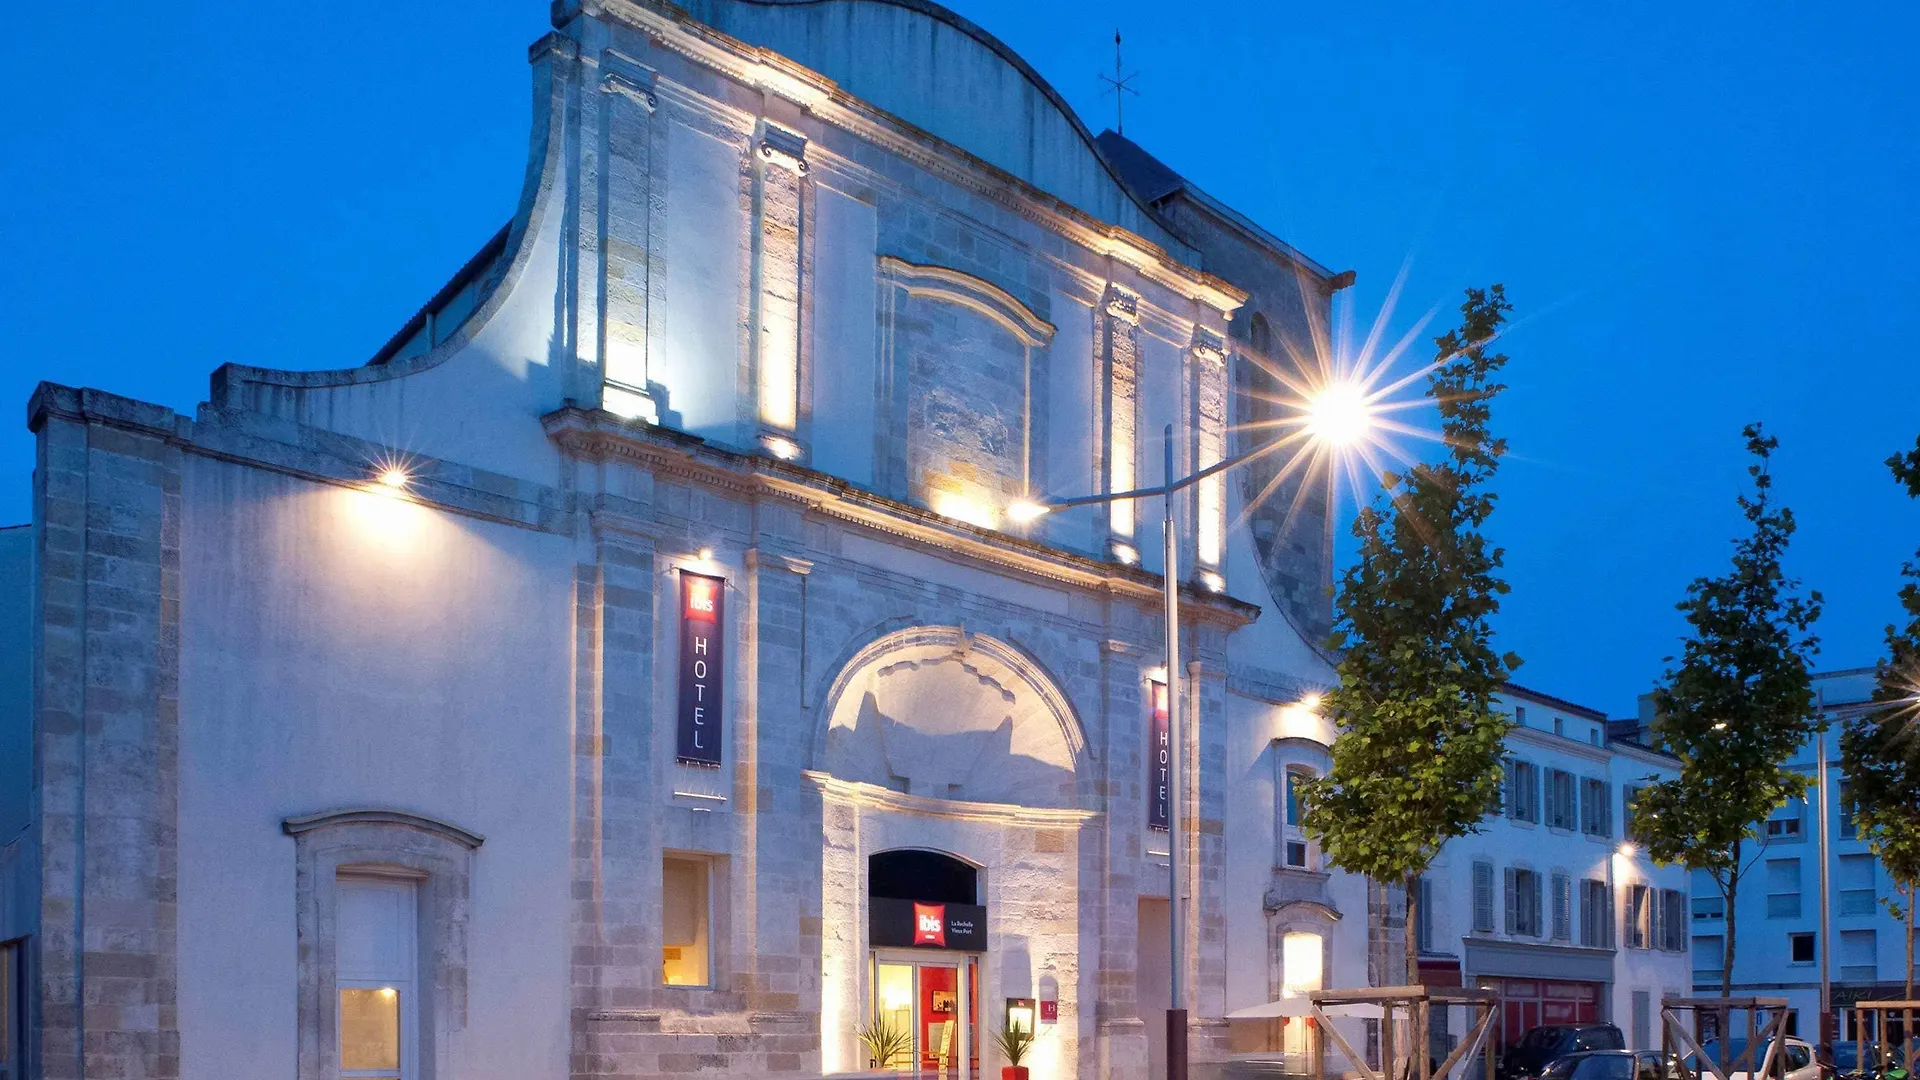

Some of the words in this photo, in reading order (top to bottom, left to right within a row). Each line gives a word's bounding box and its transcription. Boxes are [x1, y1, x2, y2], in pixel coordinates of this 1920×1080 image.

[690, 592, 714, 613] ibis
[694, 636, 707, 749] HOTEL
[1159, 731, 1168, 818] HOTEL
[919, 914, 941, 933] ibis
